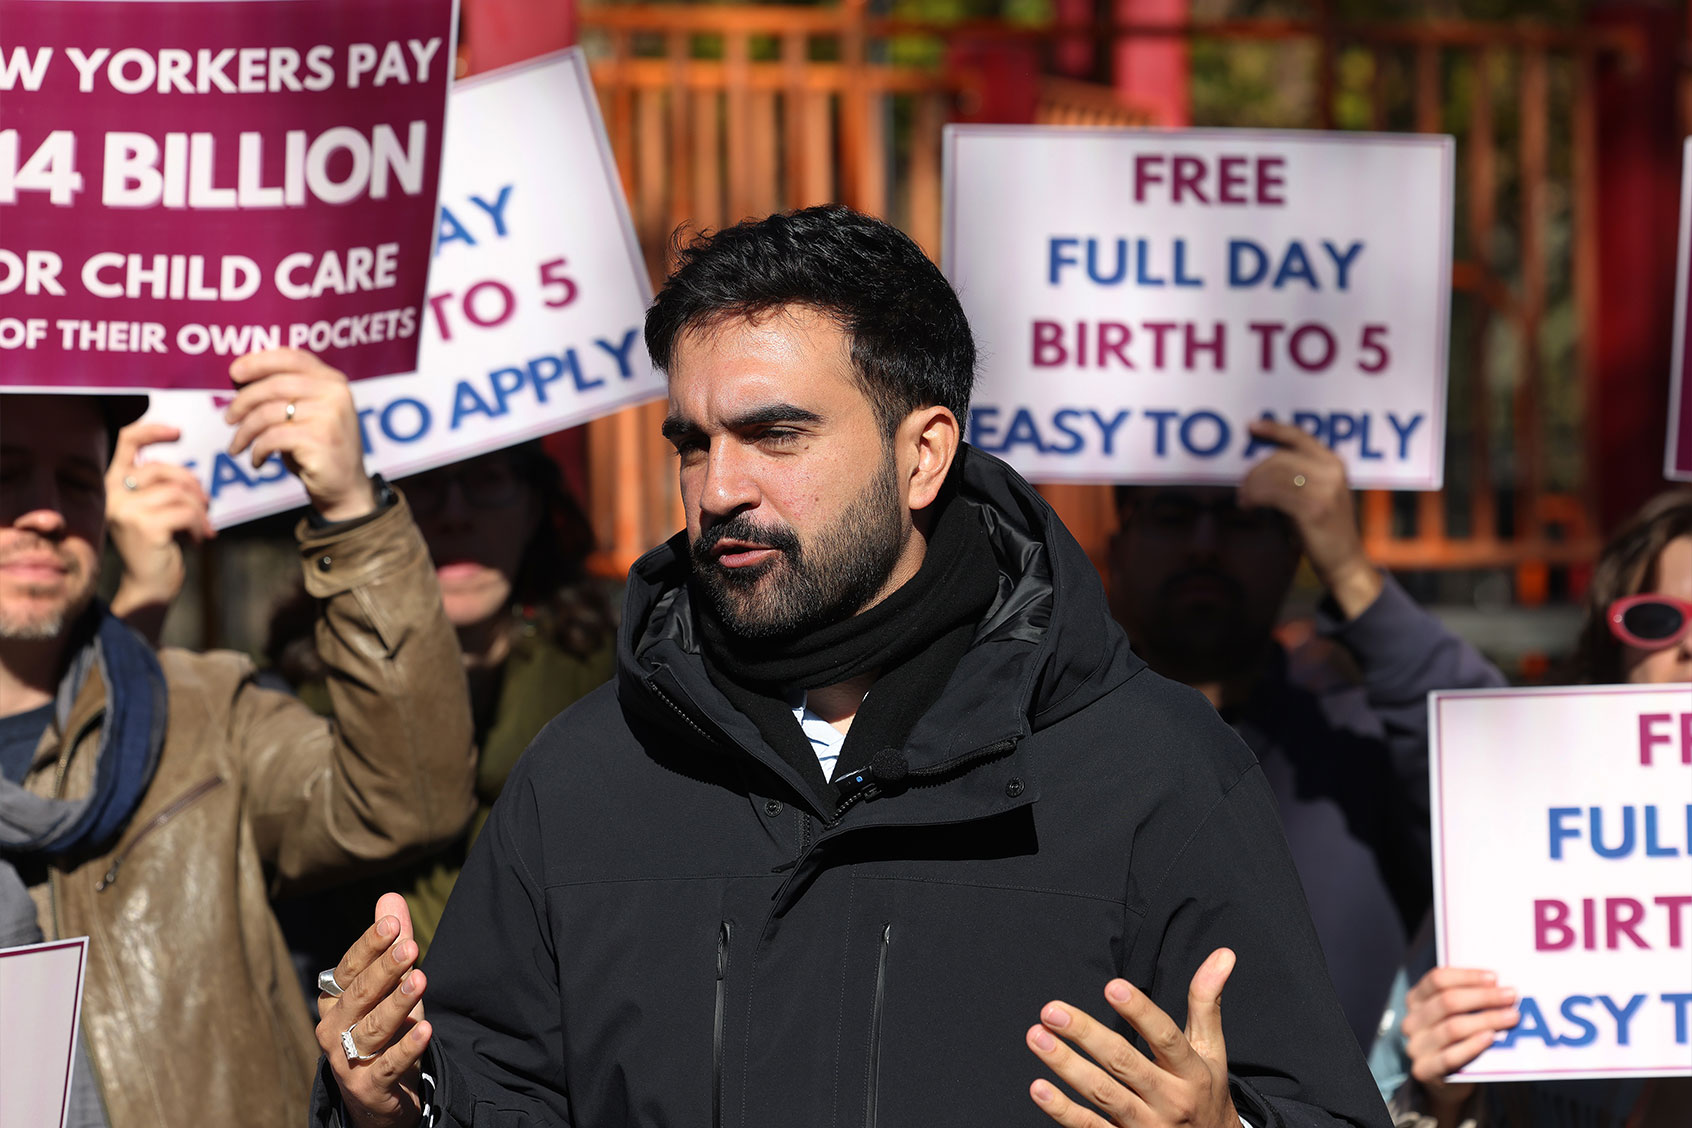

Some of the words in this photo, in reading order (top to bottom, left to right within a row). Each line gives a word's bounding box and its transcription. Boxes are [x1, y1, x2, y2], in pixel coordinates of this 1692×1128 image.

[0, 46, 54, 91] W
[65, 46, 335, 94] YORKERS
[347, 37, 442, 88] PAY
[0, 128, 84, 204] 14
[101, 120, 427, 208] BILLION
[1133, 154, 1286, 206] FREE
[0, 248, 66, 296] OR
[81, 252, 262, 301] CHILD
[274, 243, 399, 300] CARE
[1048, 237, 1204, 287] FULL
[1227, 240, 1365, 290] DAY
[428, 292, 515, 341] TO
[539, 256, 578, 309] 5
[0, 317, 48, 350] OF
[56, 319, 168, 353] THEIR
[176, 323, 280, 355] OWN
[287, 307, 416, 352] POCKETS
[1030, 320, 1226, 371] BIRTH
[1250, 322, 1337, 372] TO
[1357, 325, 1390, 374] 5
[358, 398, 432, 455] TO
[450, 329, 639, 430] APPLY
[970, 408, 1131, 457] EASY
[1144, 409, 1232, 459] TO
[1533, 896, 1692, 951] BIRT
[1491, 995, 1648, 1048] ASY
[1661, 994, 1692, 1045] T
